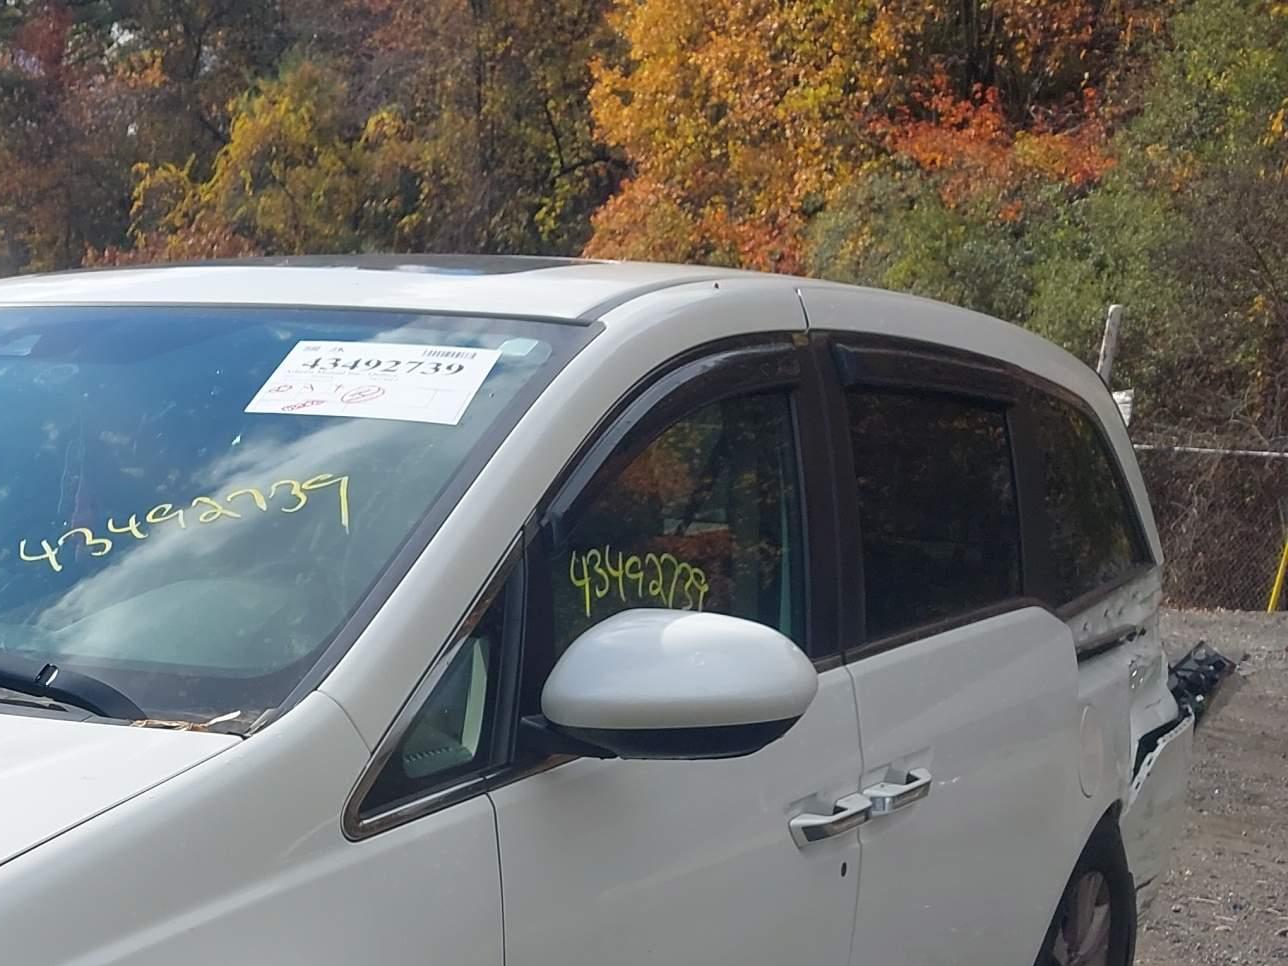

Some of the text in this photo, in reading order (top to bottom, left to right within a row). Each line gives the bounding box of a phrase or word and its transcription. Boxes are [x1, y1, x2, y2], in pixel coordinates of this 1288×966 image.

[301, 356, 465, 376] 43492739
[19, 473, 350, 572] 43492739
[569, 544, 710, 618] 43492739
